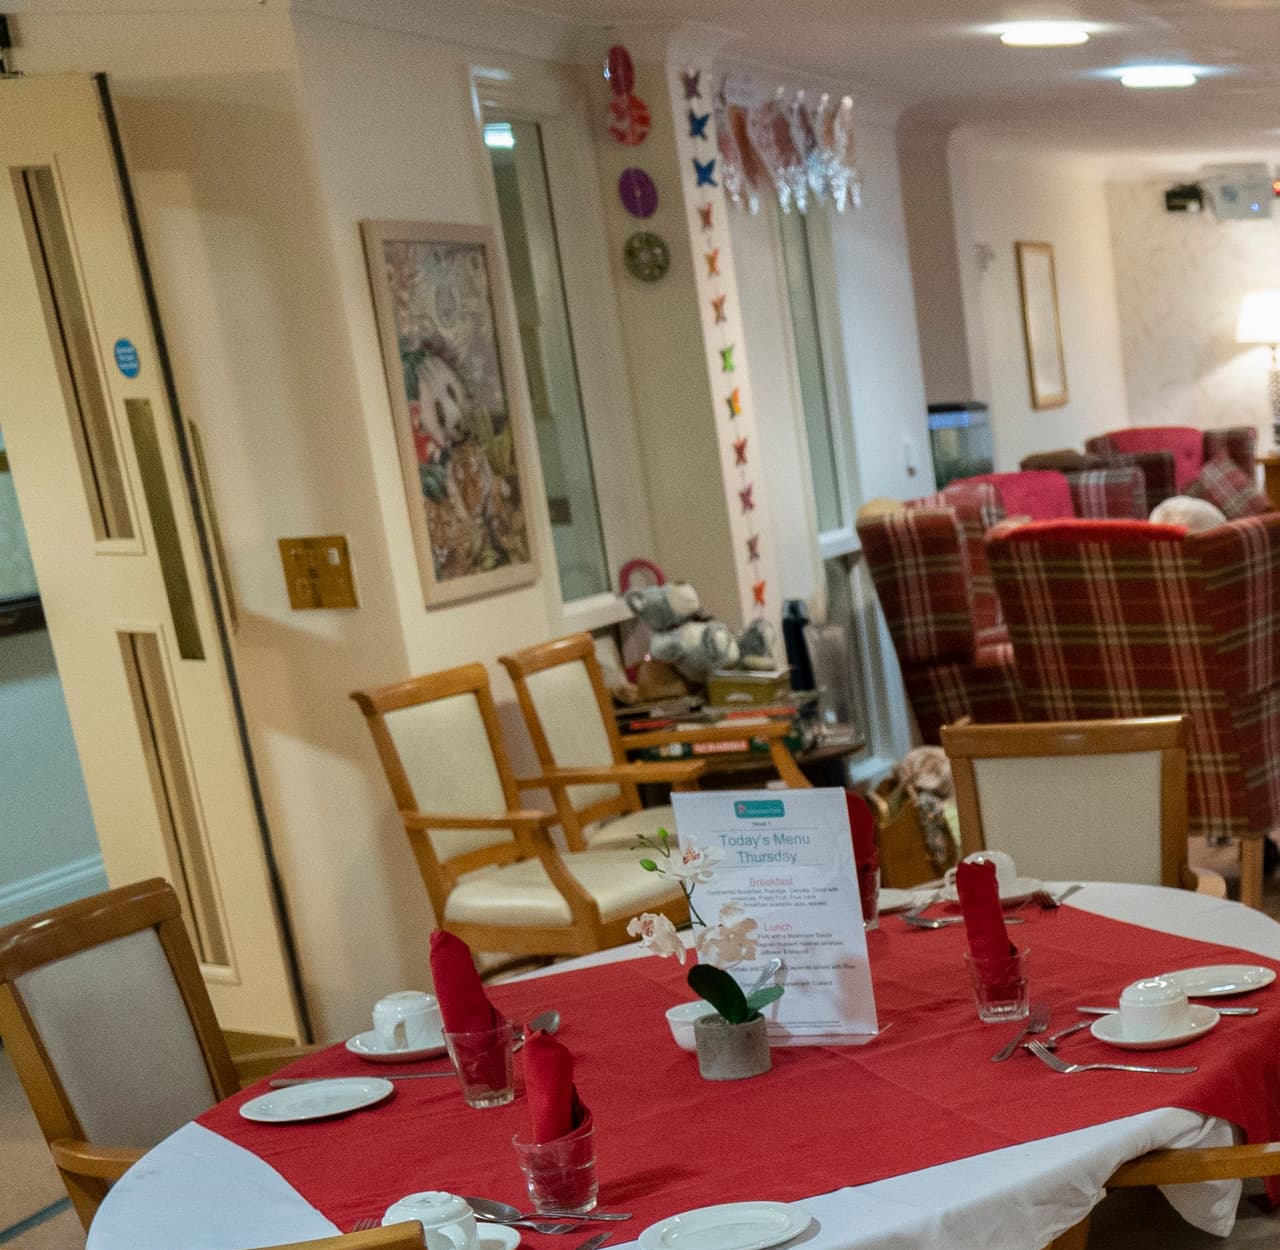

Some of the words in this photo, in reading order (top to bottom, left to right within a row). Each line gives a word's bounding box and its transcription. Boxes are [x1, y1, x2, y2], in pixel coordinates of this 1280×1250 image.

[719, 834, 770, 849] Today's
[773, 833, 810, 845] Menu
[737, 850, 797, 864] Thursday
[763, 922, 793, 932] Lunch
